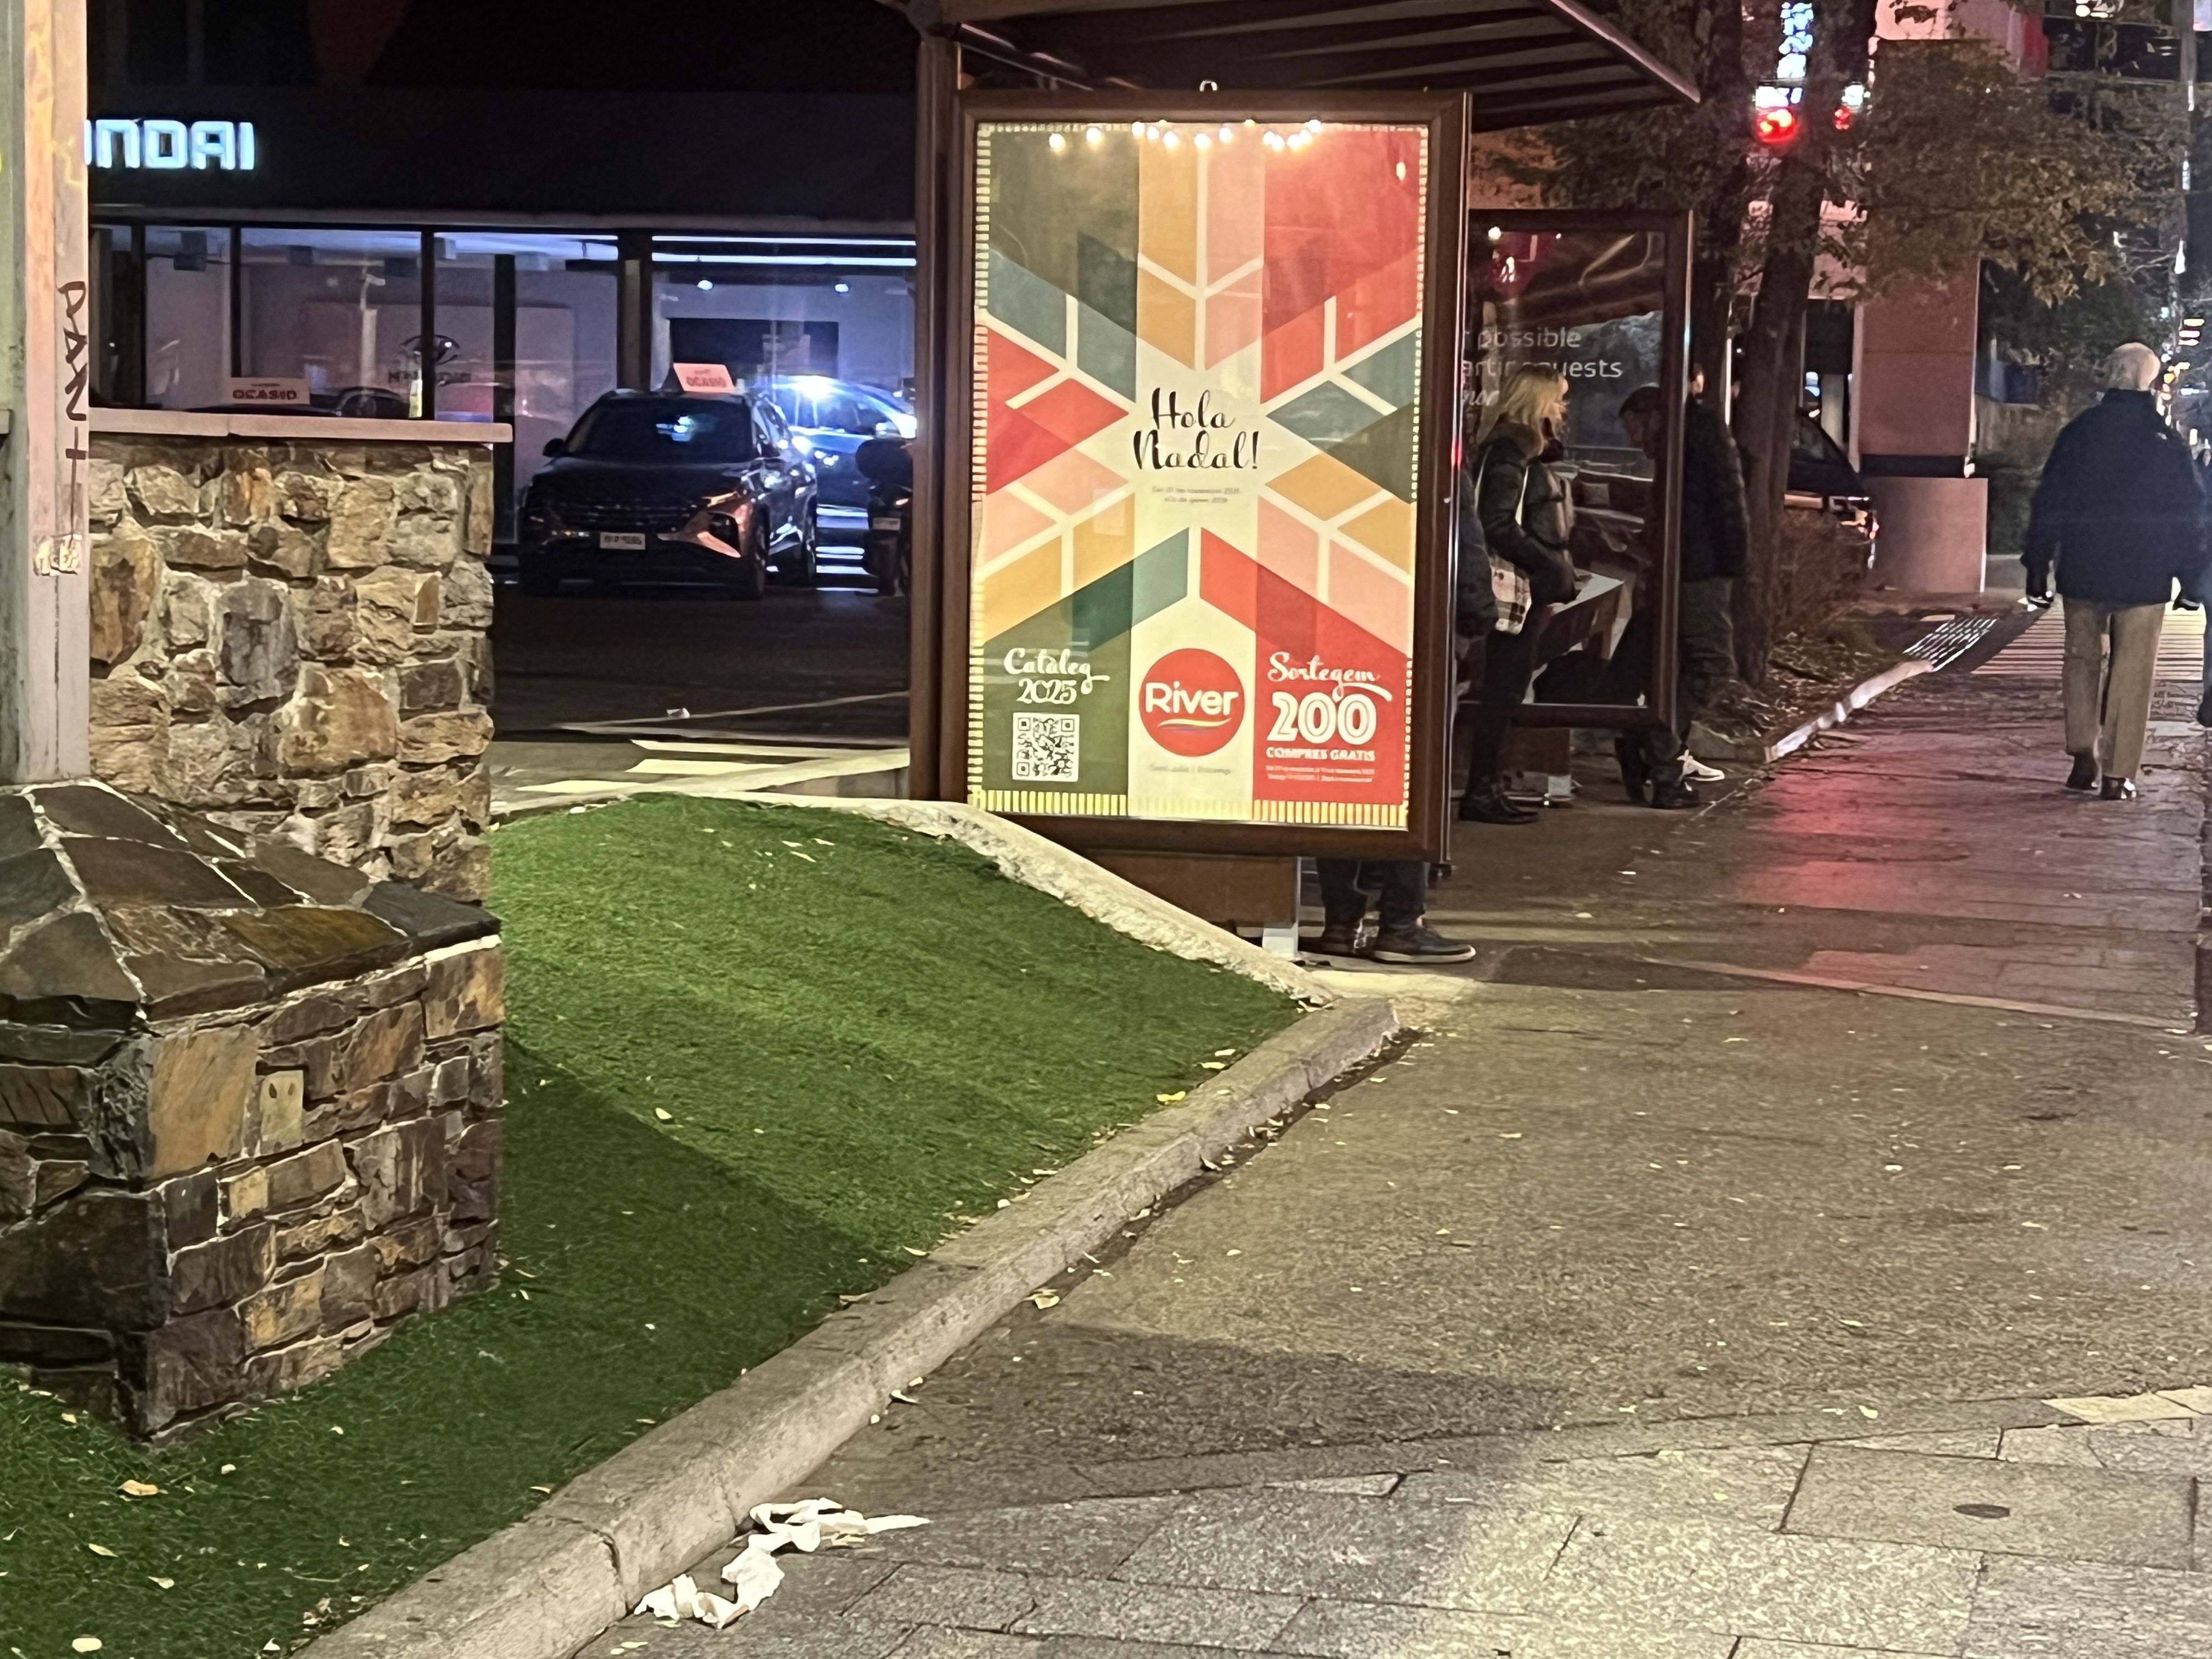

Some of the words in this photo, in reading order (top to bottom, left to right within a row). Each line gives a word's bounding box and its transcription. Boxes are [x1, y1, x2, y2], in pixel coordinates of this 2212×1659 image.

[1478, 326, 1582, 350] possible
[1151, 387, 1235, 429] Hola
[1133, 430, 1259, 470] Nadal!
[1017, 678, 1077, 704] 2025
[1267, 651, 1393, 702] Sortegem
[1145, 681, 1239, 715] River
[1266, 691, 1376, 745] 200
[1266, 747, 1328, 760] COMPRES
[1330, 749, 1375, 761] GRATIS
